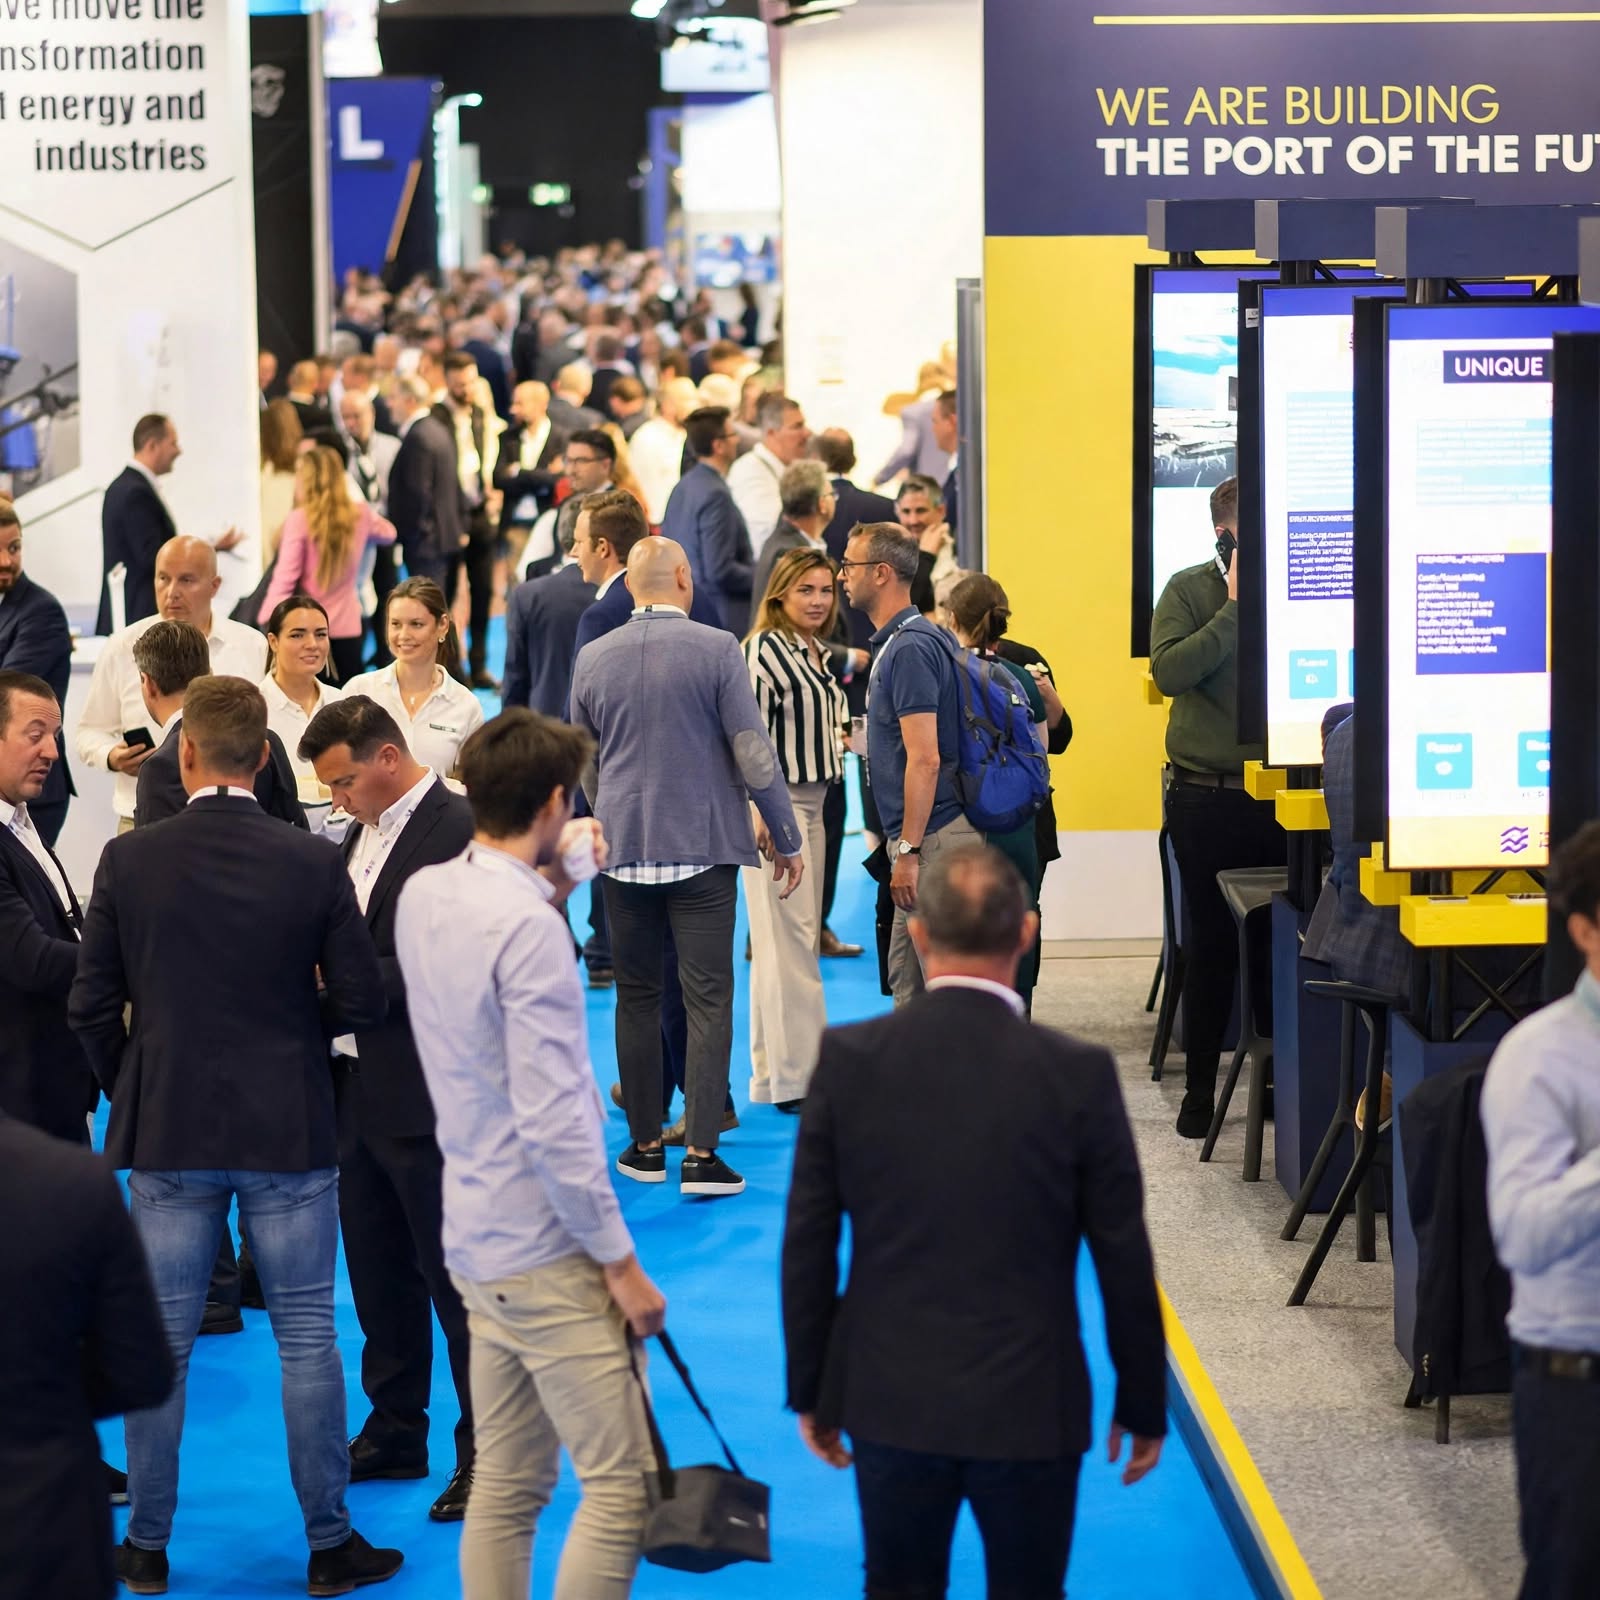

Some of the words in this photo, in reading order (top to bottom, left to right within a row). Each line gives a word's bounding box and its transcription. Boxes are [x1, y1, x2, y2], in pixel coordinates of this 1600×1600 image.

[52, 0, 141, 20] move
[0, 38, 205, 71] nsformation
[19, 95, 135, 127] energy
[145, 88, 205, 121] and
[1096, 86, 1169, 126] WE
[1183, 86, 1269, 126] ARE
[1285, 83, 1500, 125] BUILDING
[338, 105, 385, 161] L
[35, 138, 207, 172] industries
[1096, 137, 1190, 176] THE
[1203, 136, 1333, 176] PORT
[1345, 135, 1414, 175] OF
[1426, 134, 1520, 174] THE
[1535, 133, 1600, 173] FU
[1454, 356, 1544, 377] UNIQUE
